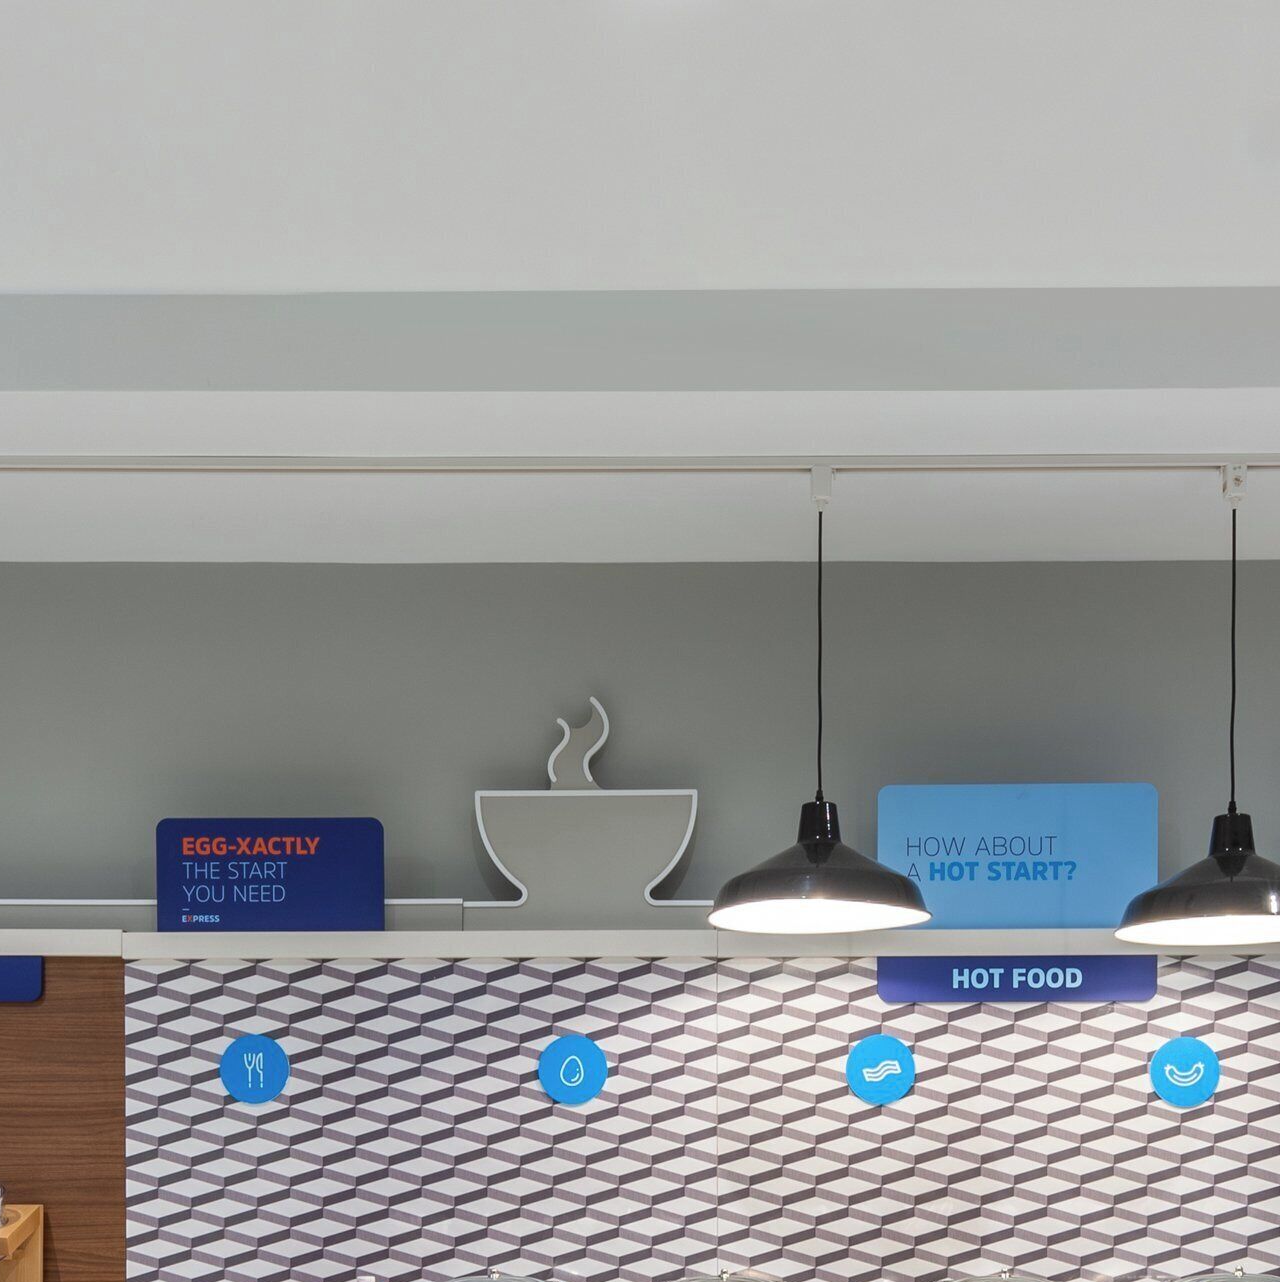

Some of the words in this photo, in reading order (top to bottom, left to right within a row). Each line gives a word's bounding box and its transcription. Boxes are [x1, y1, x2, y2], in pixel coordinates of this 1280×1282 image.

[182, 836, 320, 855] EGG-XACTLY
[906, 836, 966, 857] HOW
[974, 835, 1058, 856] ABOUT
[182, 861, 221, 880] THE
[228, 861, 288, 880] START
[907, 863, 922, 882] A
[929, 861, 979, 882] HOT
[987, 860, 1077, 881] START?
[182, 884, 225, 903] YOU
[233, 884, 286, 903] NEED
[181, 914, 220, 923] EXPRESS
[952, 968, 1005, 989] HOT
[1012, 968, 1083, 989] FOOD
